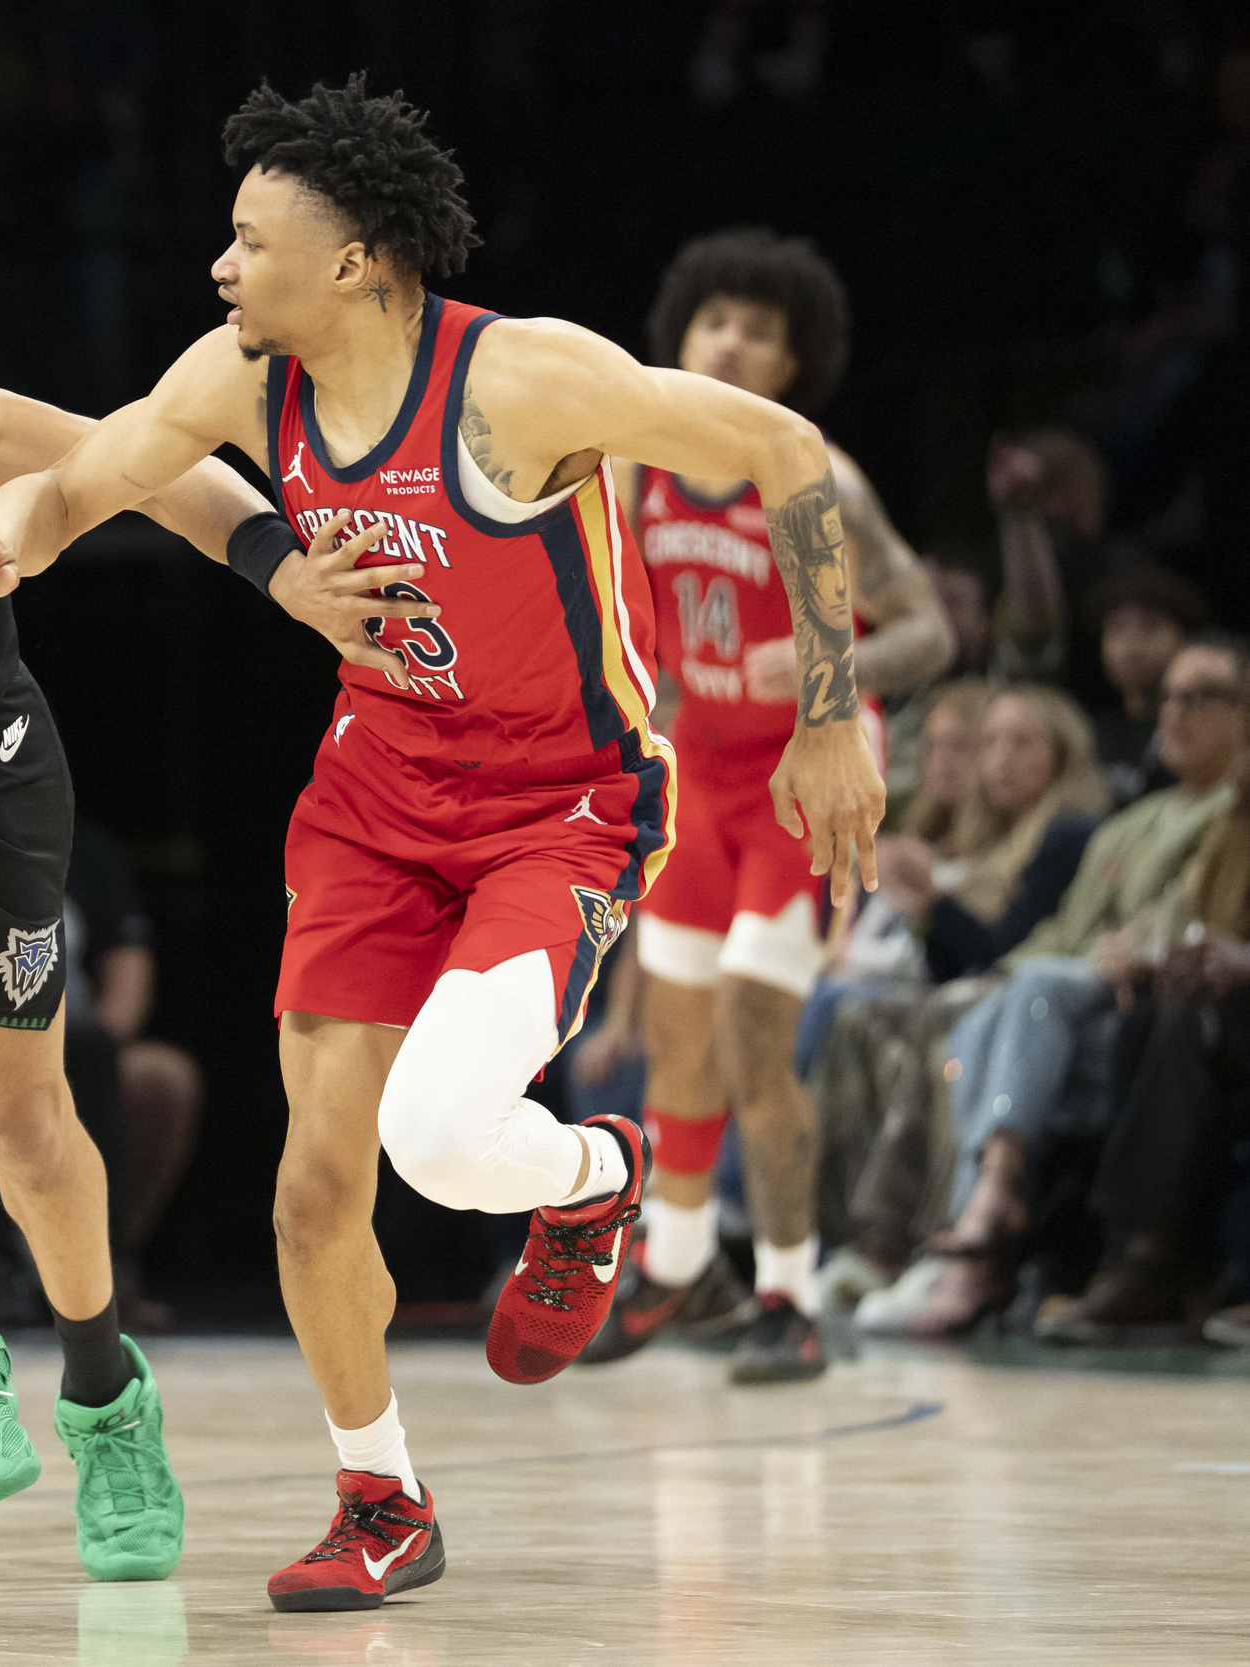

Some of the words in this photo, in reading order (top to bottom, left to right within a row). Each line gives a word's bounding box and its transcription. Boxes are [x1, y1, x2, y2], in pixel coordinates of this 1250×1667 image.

[379, 467, 440, 485] NEWAGE
[386, 485, 436, 496] PRODUCTS
[672, 570, 740, 662] 14
